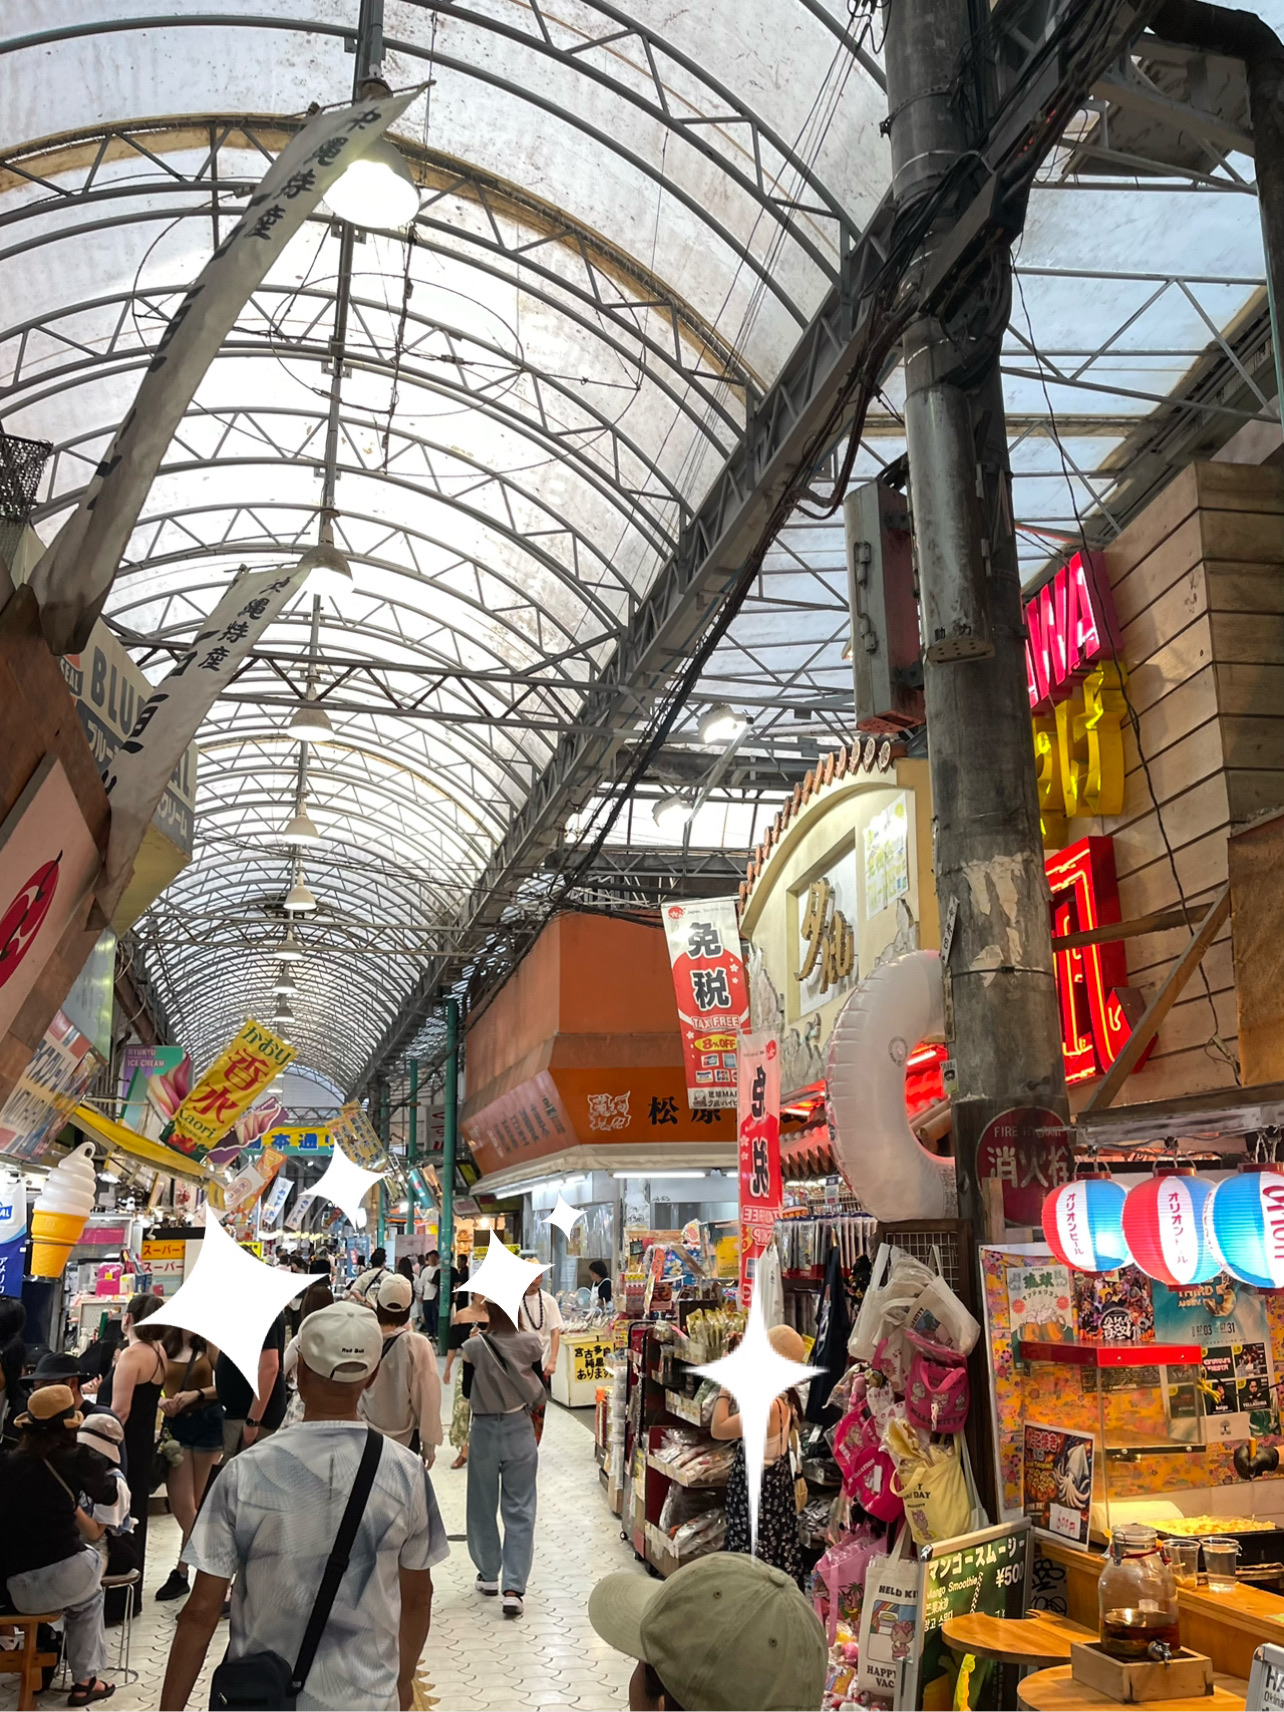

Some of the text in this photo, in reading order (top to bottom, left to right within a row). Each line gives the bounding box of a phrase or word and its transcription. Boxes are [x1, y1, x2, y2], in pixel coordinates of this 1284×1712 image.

[91, 646, 146, 737] BLU
[688, 921, 731, 1010] 免税
[692, 1016, 739, 1029] TAX FREE
[242, 1025, 291, 1066] かおり
[127, 1059, 165, 1068] ICE CREAM
[189, 1047, 271, 1124] 香水
[250, 1133, 334, 1150] 本通
[994, 1126, 1017, 1138] FIRE
[987, 1145, 1070, 1188] 消火栓
[1066, 1193, 1084, 1255] オリオンビール
[1168, 1192, 1188, 1264] オリオンル
[143, 1244, 185, 1256] スーパー
[1023, 1271, 1055, 1290] 琉球
[1203, 1324, 1213, 1336] 03
[1227, 1322, 1236, 1334] 31
[928, 1537, 1025, 1581] マンゴースムージー
[948, 1574, 979, 1592] Smoothie
[996, 1560, 1024, 1588] ¥500
